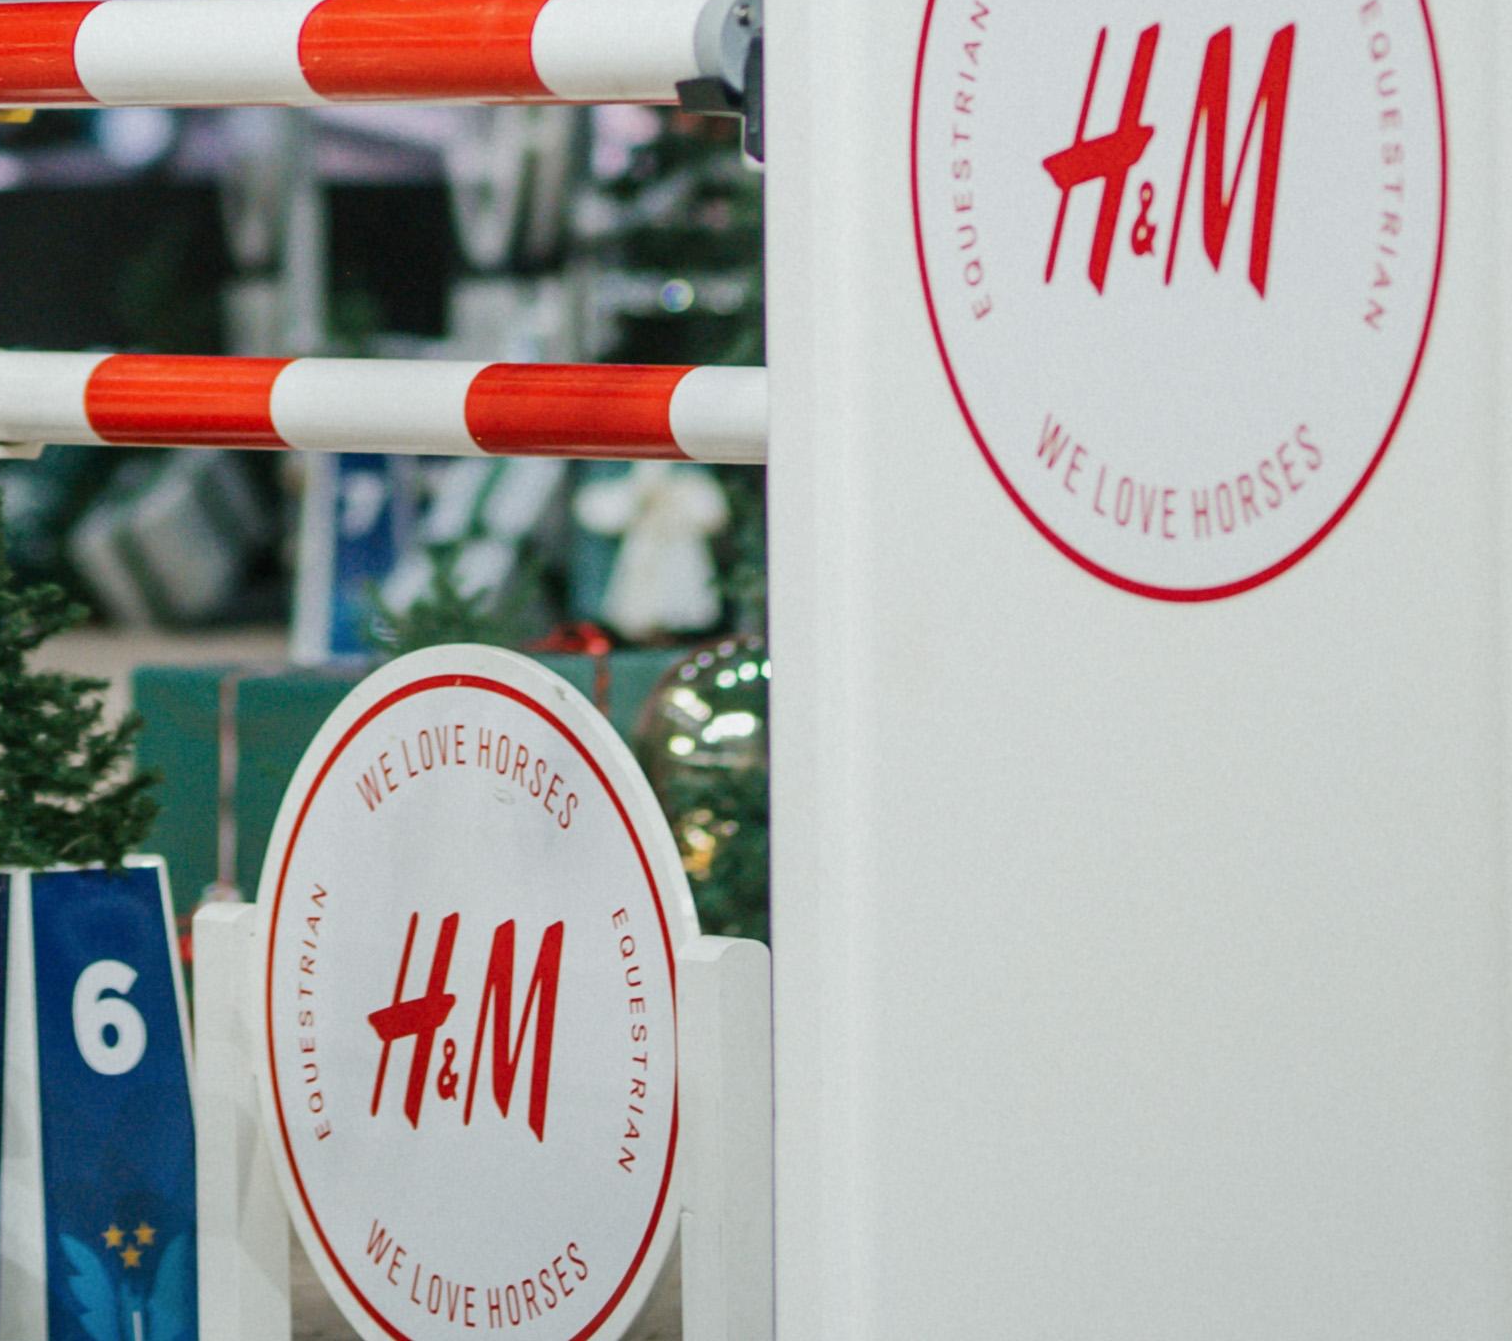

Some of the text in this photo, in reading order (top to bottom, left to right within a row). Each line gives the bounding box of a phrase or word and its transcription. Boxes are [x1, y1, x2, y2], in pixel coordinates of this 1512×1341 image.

[951, 0, 992, 320] EQUESTRIAN
[1042, 22, 1295, 299] H&M
[1038, 413, 1322, 539] WE LOVE HORSES
[356, 724, 579, 829] WE LOVE HORSES
[72, 959, 147, 1076] 6
[299, 883, 329, 1141] EQUESTRIAN
[368, 911, 564, 1143] H&M
[611, 908, 649, 1174] EQUESTRIAN
[367, 1219, 588, 1329] WE LOVE HORSES
